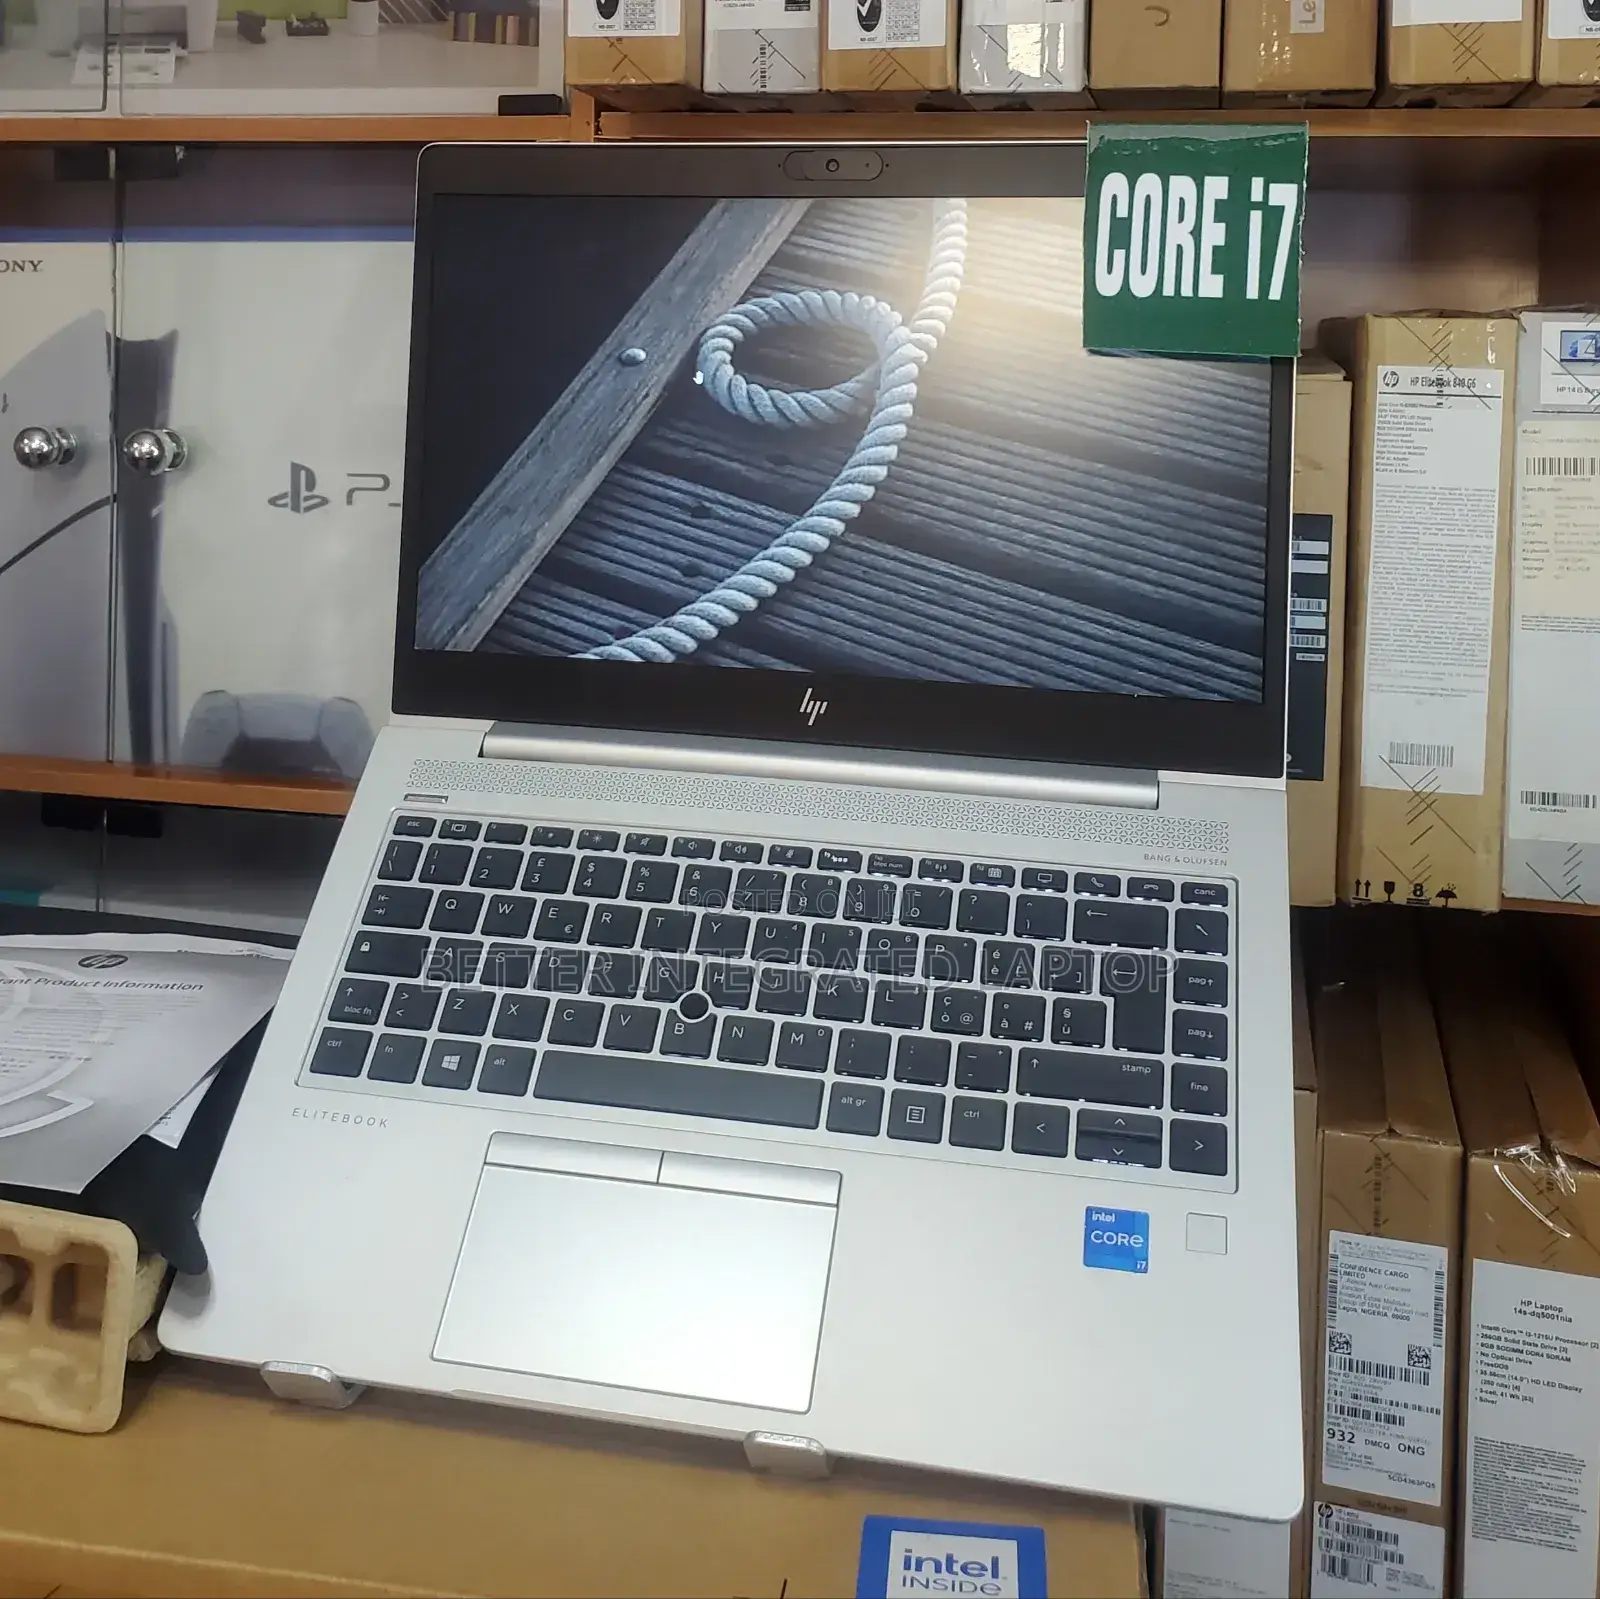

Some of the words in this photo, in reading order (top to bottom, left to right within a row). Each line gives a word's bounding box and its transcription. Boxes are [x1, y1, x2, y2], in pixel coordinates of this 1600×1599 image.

[1298, 0, 1316, 24] Le
[1095, 172, 1229, 298] CORE
[1246, 176, 1298, 301] i7
[0, 259, 44, 273] ONY
[1410, 376, 1419, 387] HP
[406, 819, 421, 828] esc
[1143, 853, 1171, 863] BANG
[1182, 856, 1228, 867] OLUFSEN
[478, 868, 490, 879] 2
[531, 873, 541, 883] 3
[582, 877, 592, 888] 4
[635, 882, 645, 893] 5
[689, 886, 698, 897] 6
[1193, 887, 1216, 897] canc
[444, 898, 457, 911] Q
[498, 902, 514, 915] W
[548, 907, 559, 919] E
[600, 912, 613, 924] R
[655, 916, 665, 928] T
[711, 921, 722, 934] Y
[765, 927, 777, 939] U
[443, 946, 454, 958] A
[935, 944, 945, 955] P
[496, 952, 506, 963] S
[548, 956, 561, 968] D
[659, 966, 671, 978] G
[713, 971, 725, 984] H
[34, 977, 102, 988] Product
[103, 980, 204, 991] Information
[1188, 976, 1207, 986] pag
[827, 983, 839, 997] K
[885, 990, 895, 1003] L
[452, 998, 466, 1010] Z
[507, 1004, 520, 1016] X
[562, 1009, 575, 1022] C
[619, 1014, 632, 1026] V
[673, 1023, 685, 1035] B
[731, 1026, 745, 1039] N
[1187, 1027, 1206, 1038] pag
[326, 1038, 342, 1048] ctrl
[790, 1032, 805, 1046] M
[493, 1057, 506, 1066] alt
[1121, 1063, 1152, 1075] stamp
[1190, 1081, 1209, 1092] fine
[841, 1095, 853, 1105] alt
[854, 1097, 867, 1107] gr
[291, 1107, 389, 1129] ELITEBOOK
[963, 1109, 980, 1119] ctrl
[1091, 1211, 1116, 1223] intel
[1136, 1260, 1147, 1270] i7
[1339, 1262, 1383, 1275] CONFIDENCE
[1383, 1269, 1409, 1279] CARGO
[1339, 1270, 1366, 1279] LIMITED
[1520, 1299, 1533, 1307] HP
[1534, 1301, 1564, 1314] Laptop
[1503, 1336, 1520, 1345] Solid
[1521, 1339, 1539, 1348] State
[1540, 1343, 1558, 1352] Drive
[1555, 1336, 1589, 1347] Processor
[1491, 1353, 1514, 1362] Optical
[1515, 1356, 1533, 1365] Drive
[1480, 1360, 1509, 1371] FreeDOS
[1542, 1380, 1557, 1388] LED
[1557, 1382, 1583, 1393] Display
[1479, 1396, 1498, 1405] Silver
[1326, 1427, 1356, 1444] 932
[1364, 1438, 1391, 1450] DMCQ
[1397, 1442, 1426, 1456] ONG
[902, 1548, 1001, 1579] intel
